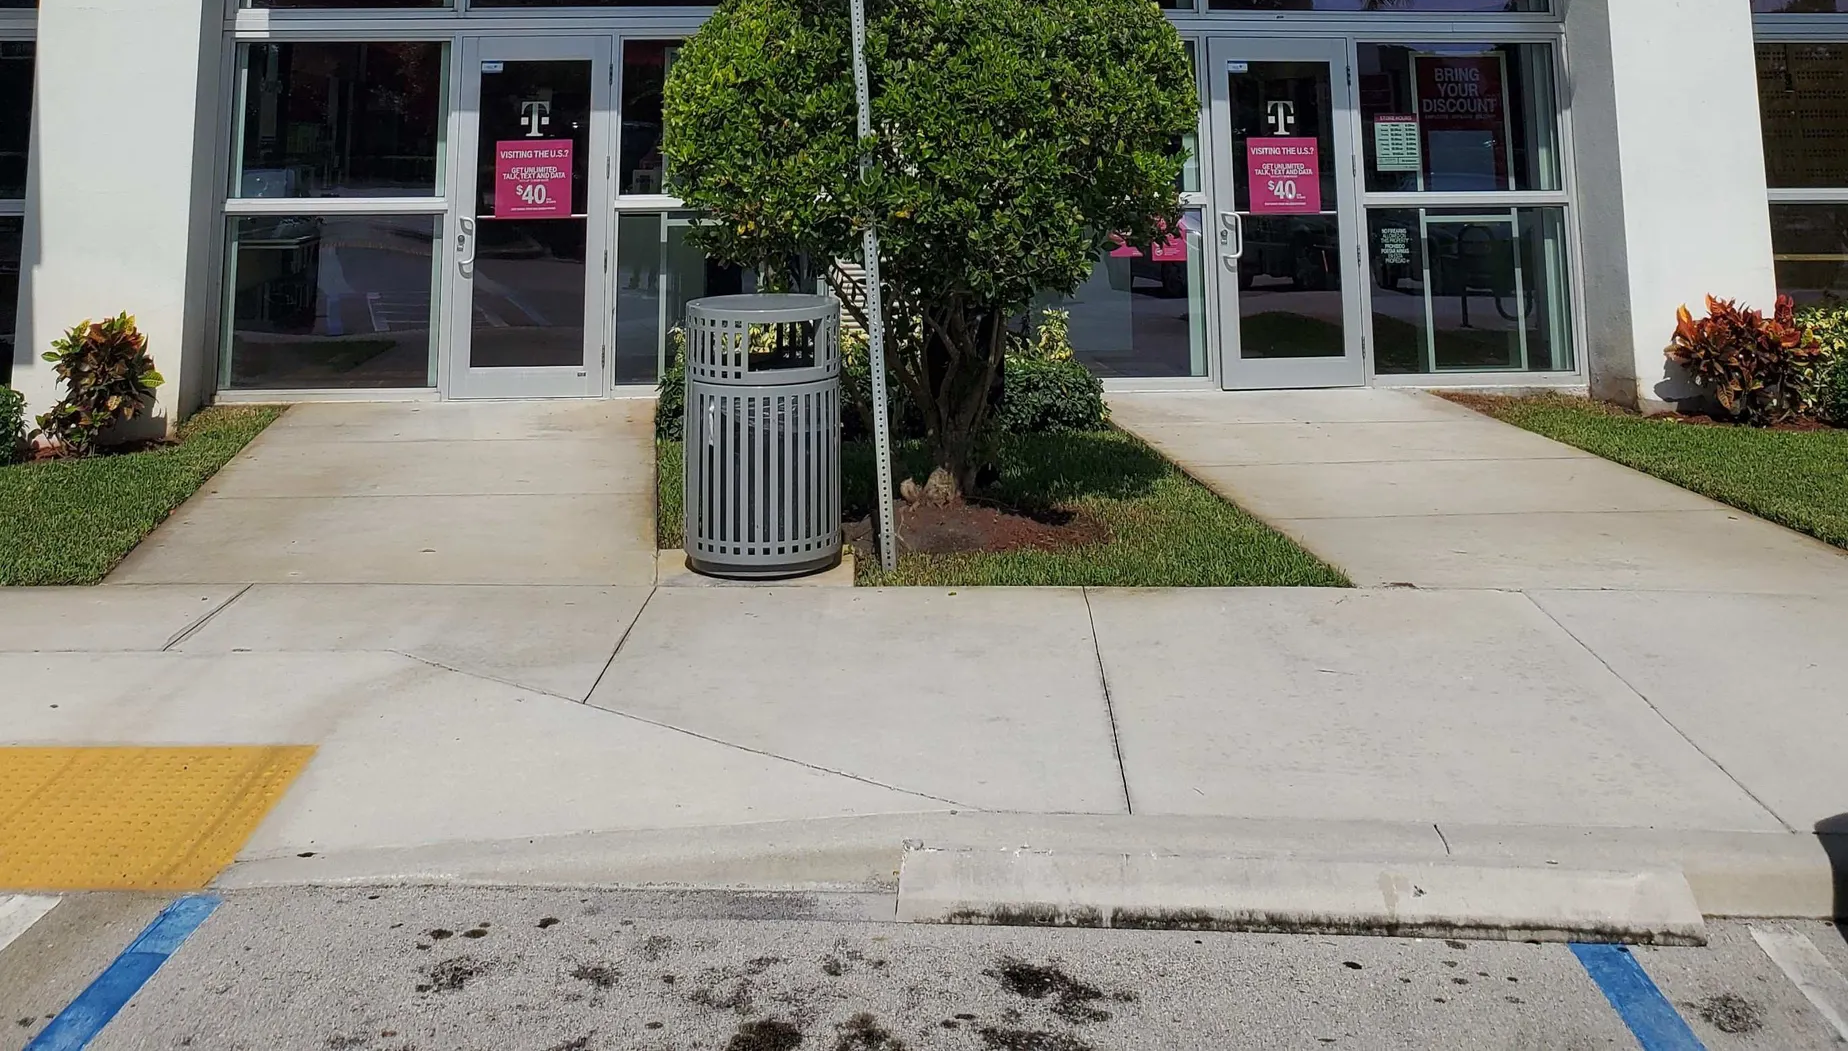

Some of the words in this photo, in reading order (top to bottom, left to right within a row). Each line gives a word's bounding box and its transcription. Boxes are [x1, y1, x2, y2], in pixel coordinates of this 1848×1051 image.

[1434, 67, 1480, 82] BRING
[1437, 82, 1479, 97] YOUR
[1422, 98, 1497, 113] DISCOUNT
[500, 150, 532, 159] VISITING
[533, 150, 549, 158] THE
[550, 149, 569, 158] U.S.?
[1250, 147, 1280, 155] VISITING
[1281, 147, 1296, 155] THE
[1297, 147, 1314, 155] U.S.?
[524, 166, 557, 174] UNLIMITED
[516, 184, 546, 204] $40
[1268, 180, 1296, 199] $40
